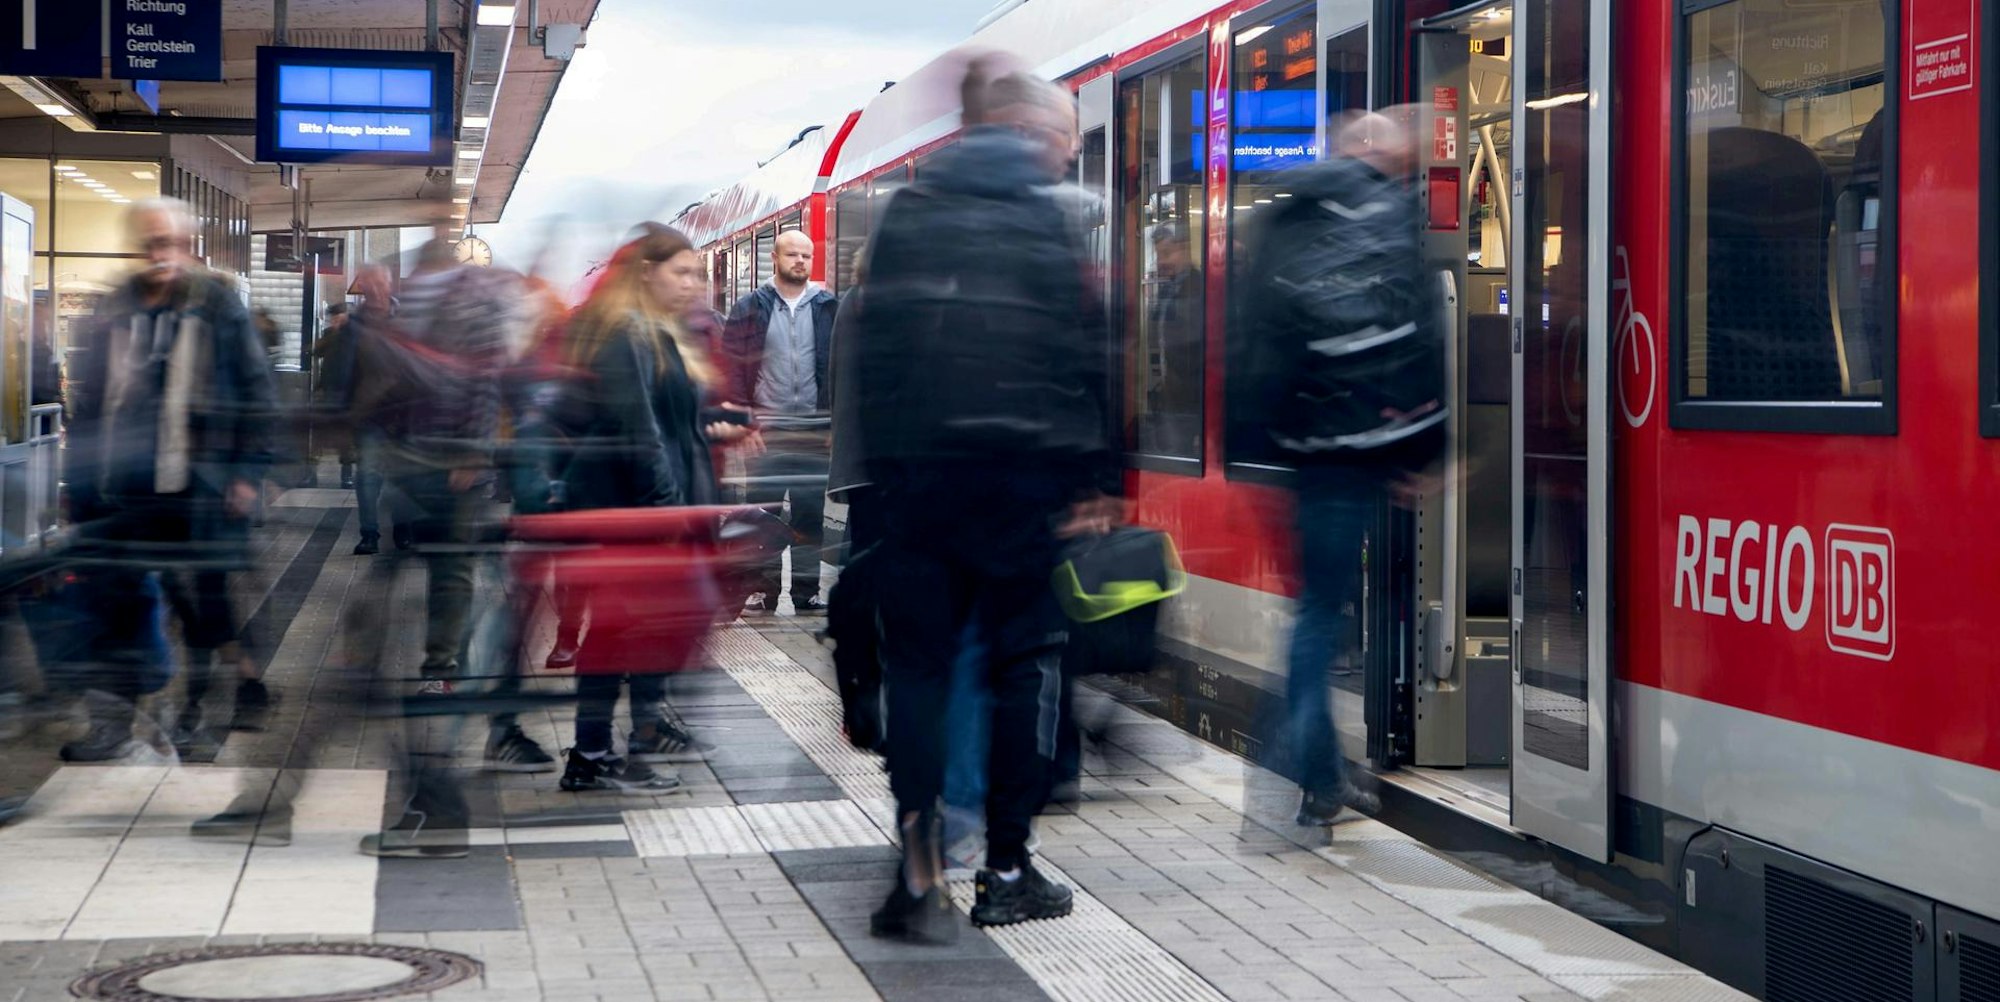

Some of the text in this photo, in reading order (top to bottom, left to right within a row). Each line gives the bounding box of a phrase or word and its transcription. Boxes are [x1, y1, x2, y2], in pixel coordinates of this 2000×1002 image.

[126, 0, 186, 16] Richtung
[126, 23, 154, 37] Kall
[126, 39, 196, 53] Gerolstein
[126, 55, 158, 69] Trier
[1915, 45, 1961, 68] Mitfahrt nur mit
[1213, 41, 1225, 112] 2
[1938, 61, 1967, 79] Fahrkarte
[328, 239, 340, 268] 1
[1673, 514, 1887, 637] REGIO DB
